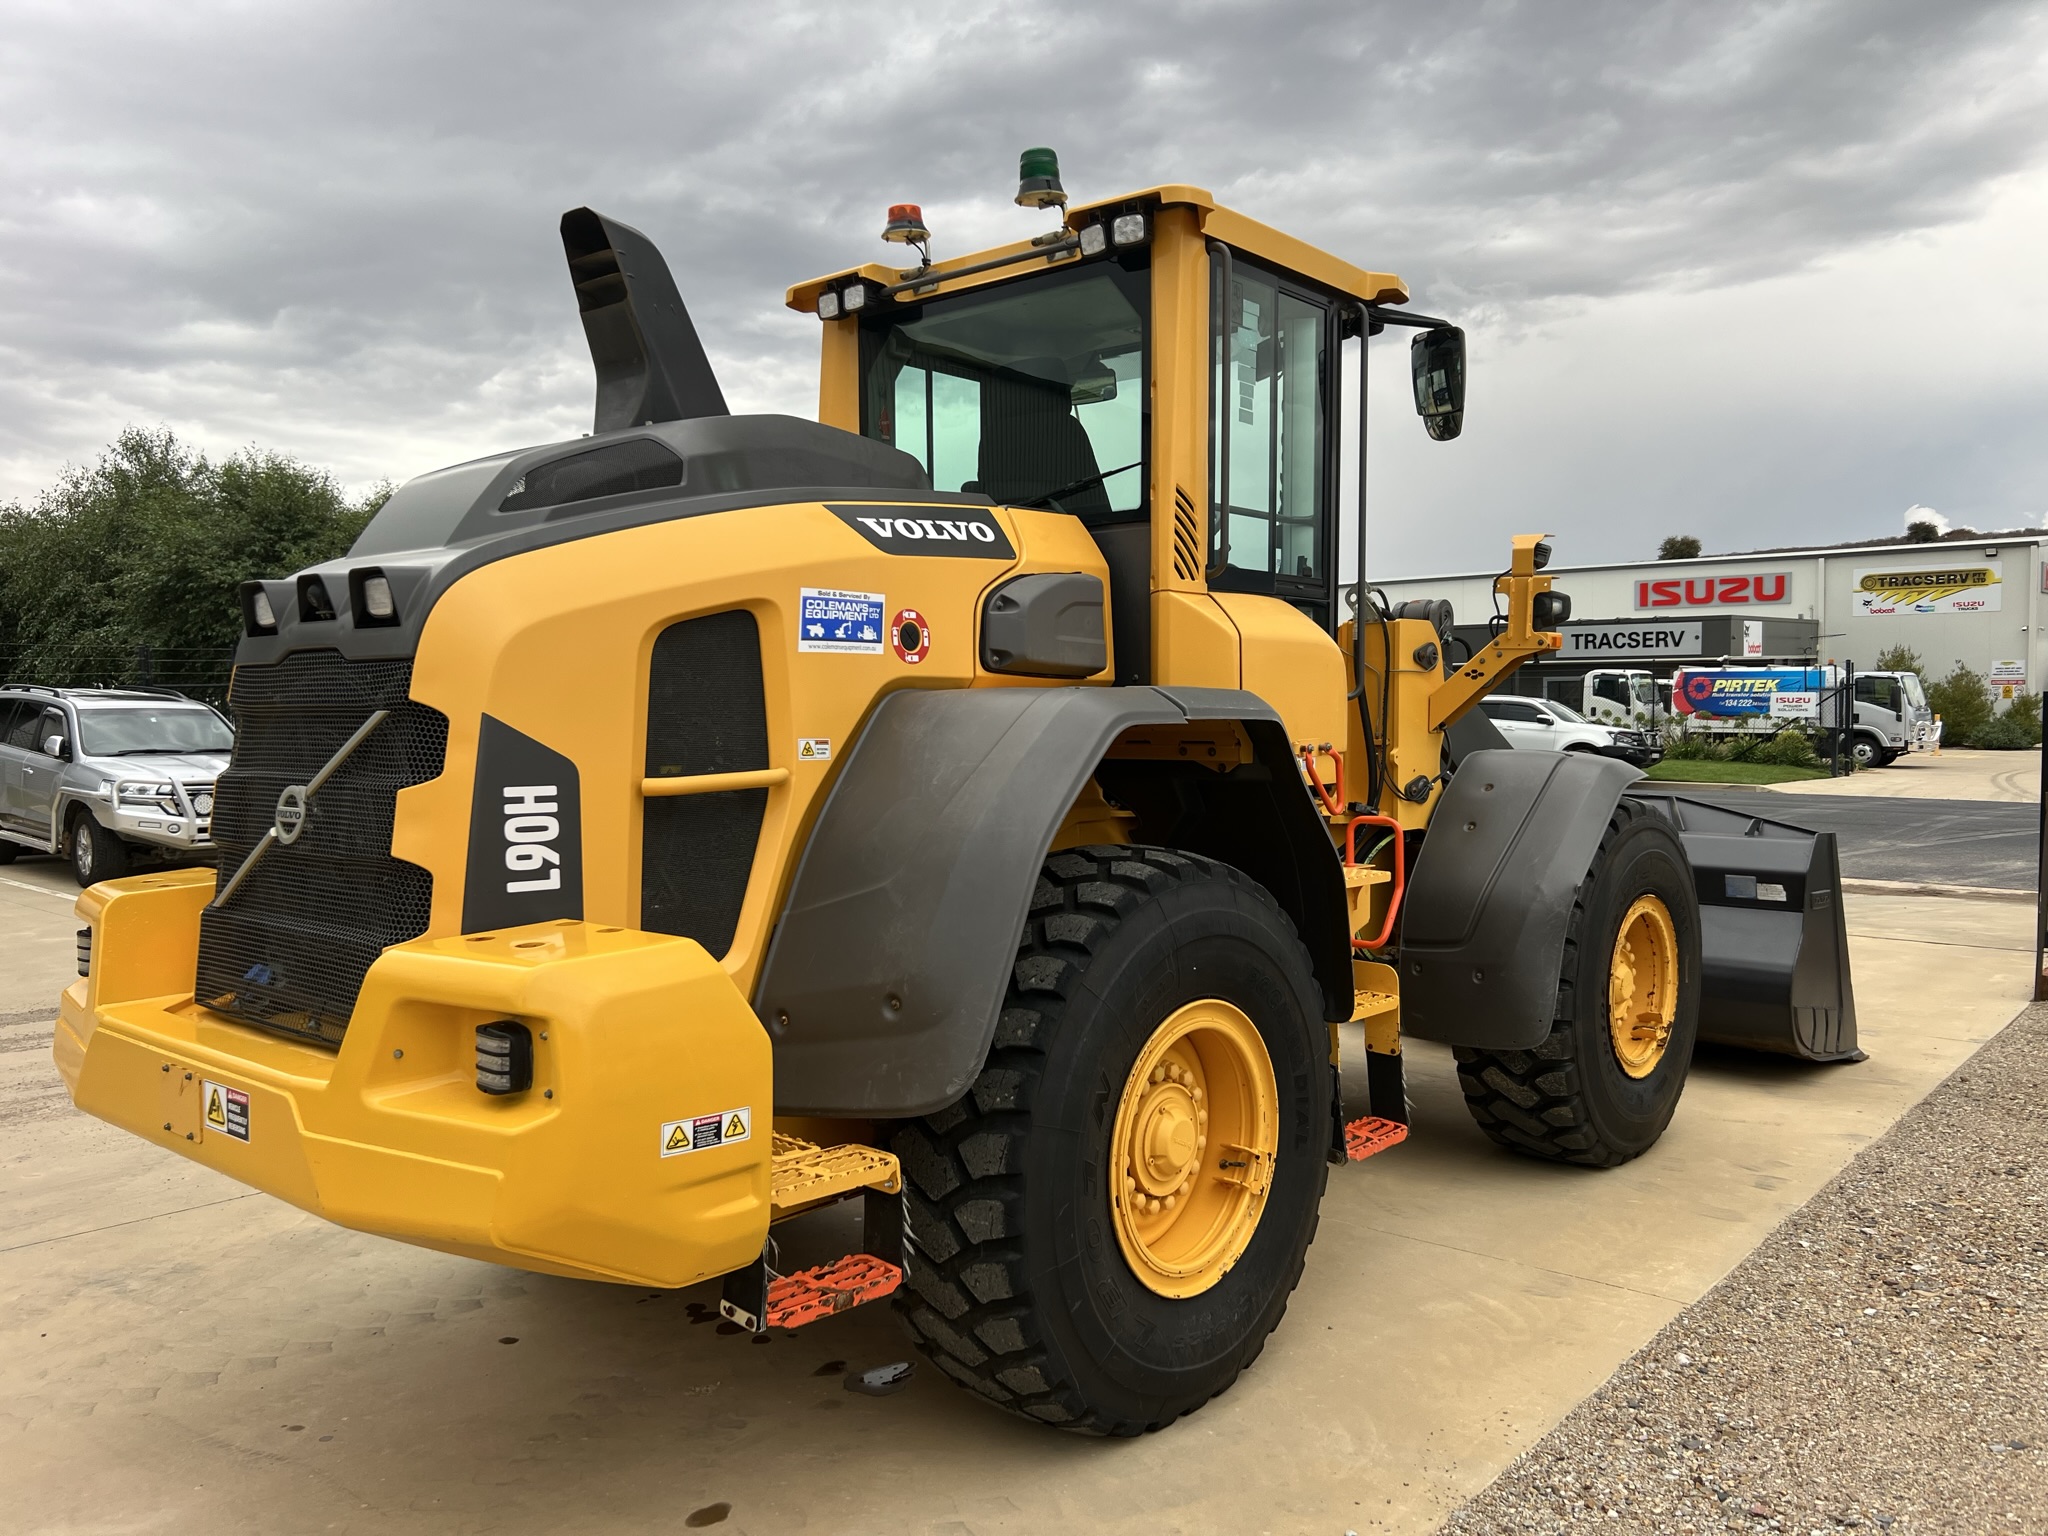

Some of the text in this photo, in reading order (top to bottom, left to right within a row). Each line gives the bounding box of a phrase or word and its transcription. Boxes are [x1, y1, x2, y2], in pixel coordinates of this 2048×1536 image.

[856, 517, 996, 543] VOLVO
[1877, 573, 1970, 588] TRACSERV
[838, 592, 862, 600] Serviced
[1639, 575, 1786, 607] ISUZU
[805, 599, 869, 613] COLEMAN'S
[1869, 607, 1896, 615] bobcat
[804, 608, 869, 622] EQUIPMENT
[1570, 630, 1686, 650] TRACSERV
[1712, 679, 1781, 692] PIRTEK
[1724, 699, 1738, 707] 134
[1738, 699, 1753, 707] 222
[276, 810, 302, 820] VOLVO
[502, 784, 561, 894] L90H
